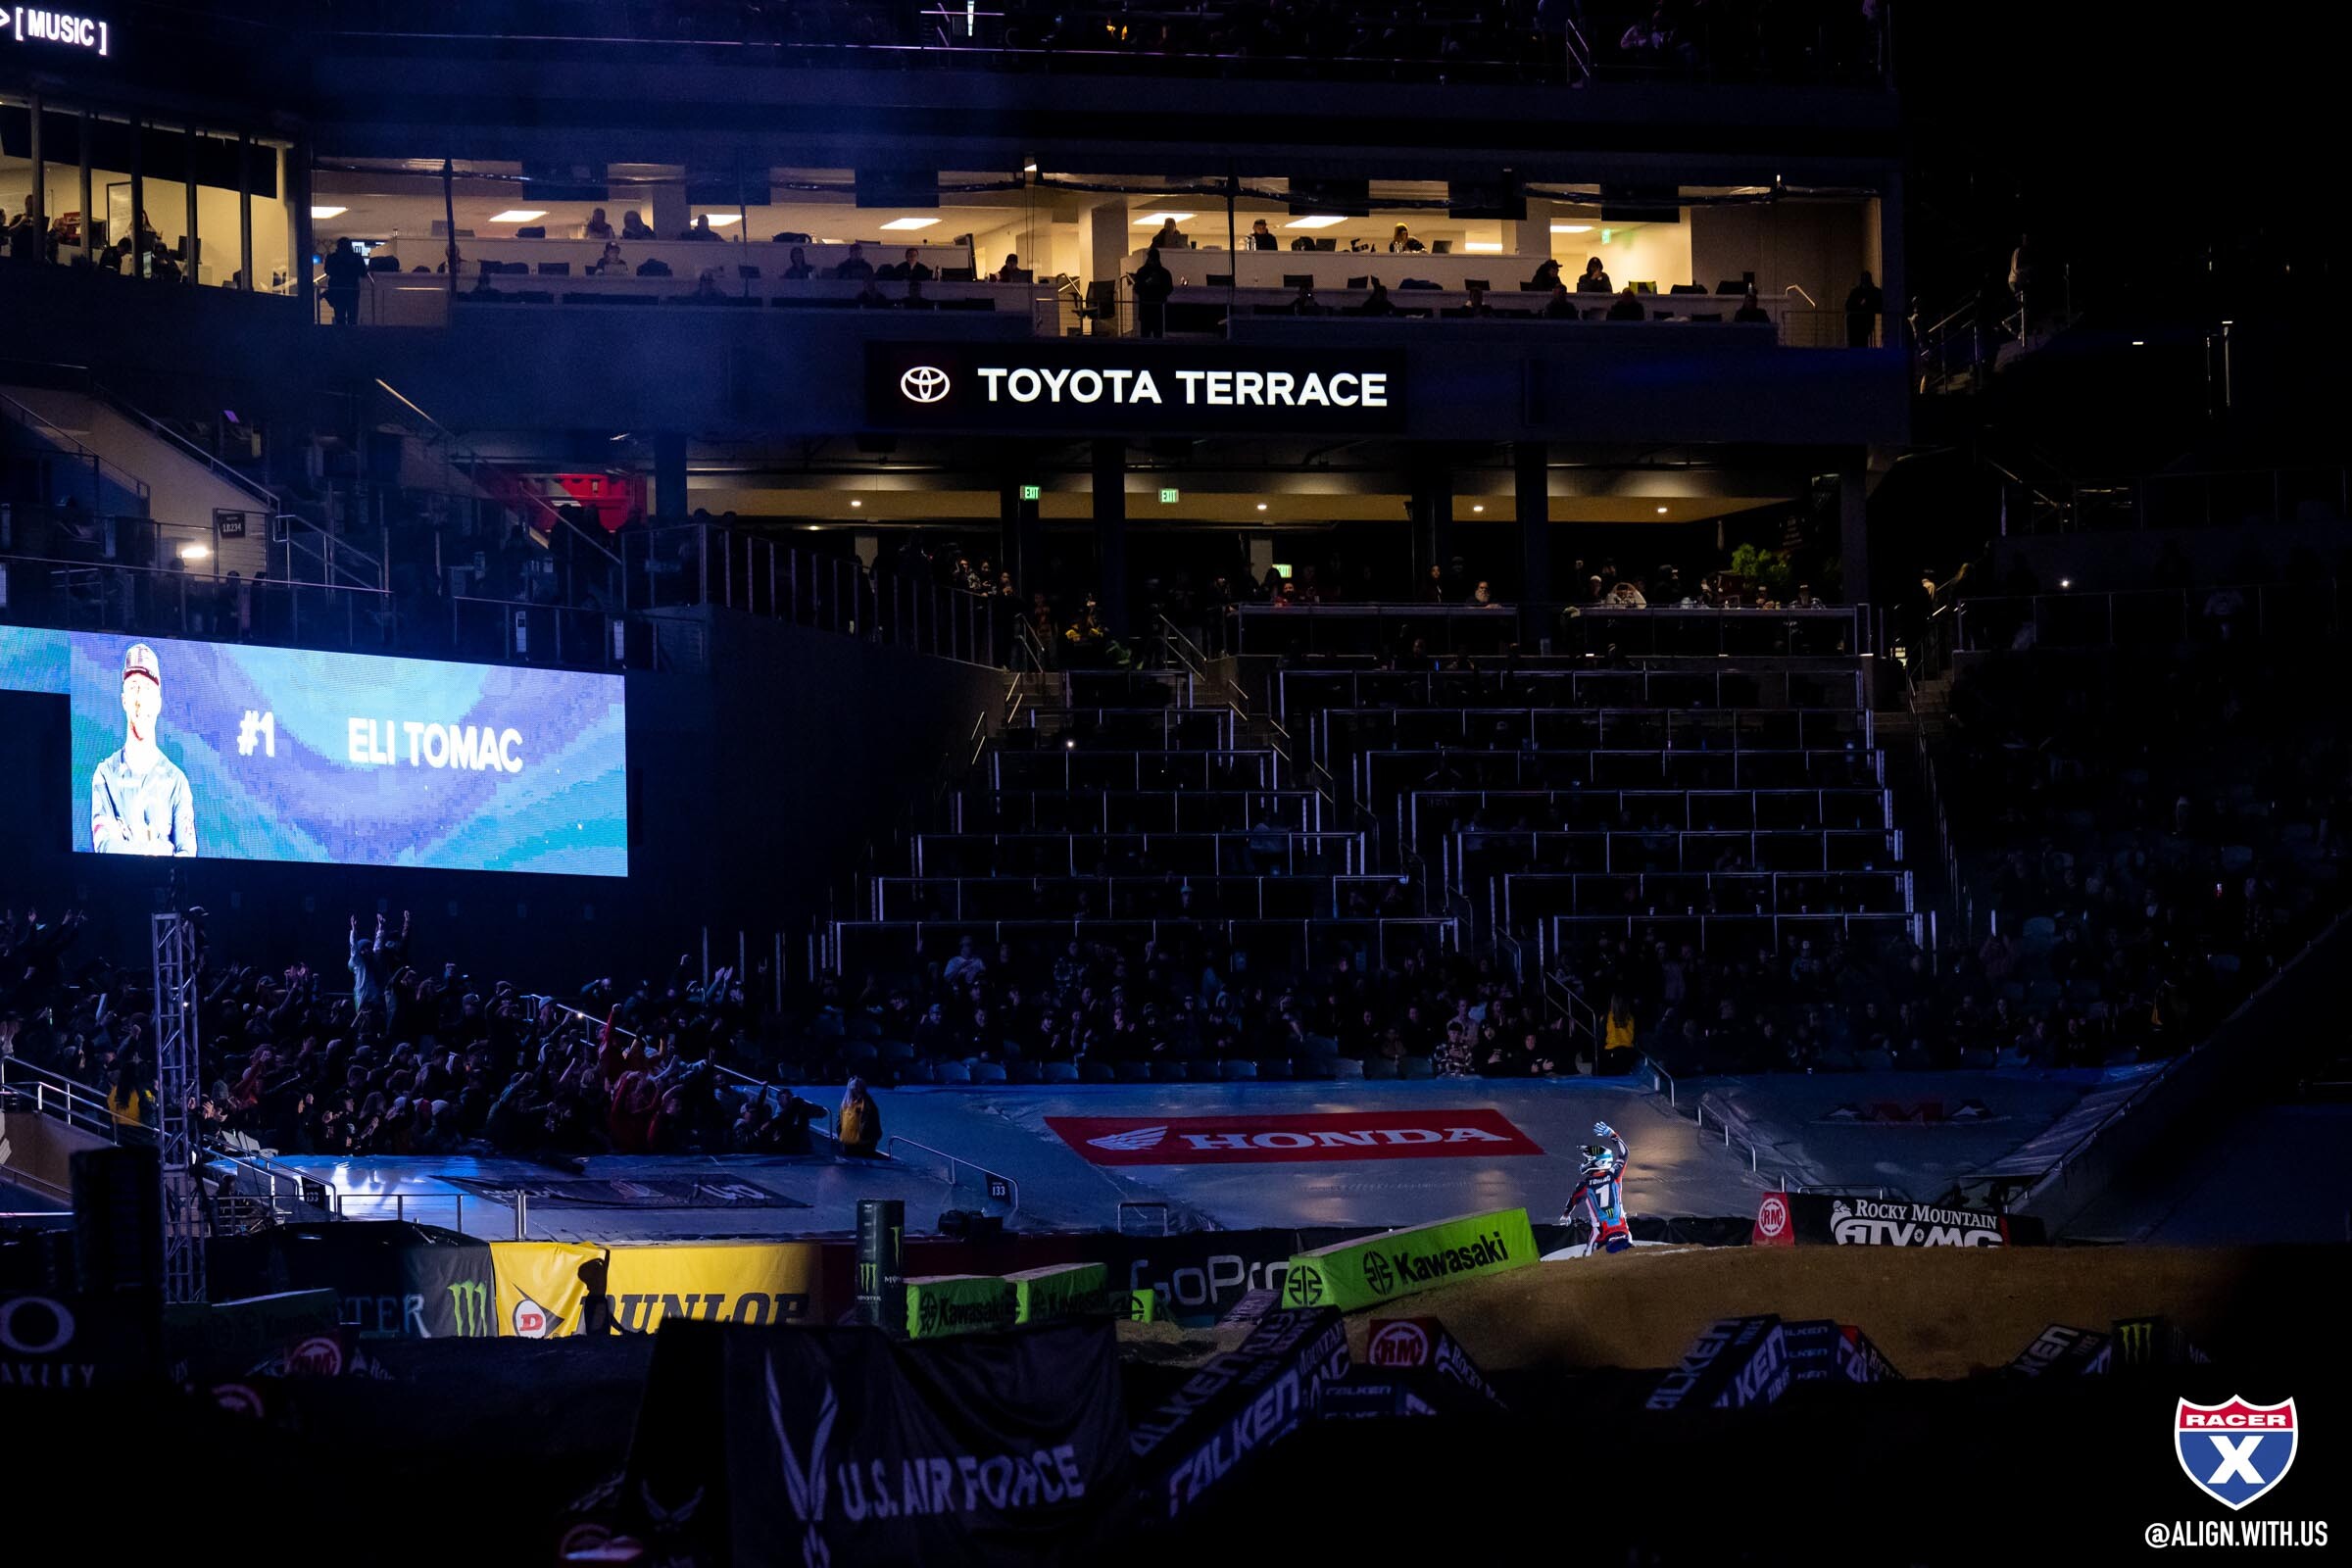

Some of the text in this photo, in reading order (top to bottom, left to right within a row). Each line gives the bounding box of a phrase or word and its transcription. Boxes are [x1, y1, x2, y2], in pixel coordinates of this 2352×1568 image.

[978, 368, 1388, 407] TOYOTA TERRACE
[1024, 486, 1039, 499] EXIT
[1161, 490, 1176, 502] EXIT
[237, 710, 523, 773] #1 ELI TOMAC
[1179, 1127, 1513, 1151] HONDA
[992, 1185, 1005, 1197] 133
[1595, 1184, 1610, 1208] 1
[1856, 1199, 1998, 1230] ROCKY MOUNTAIN
[1394, 1231, 1510, 1283] Kawasaki
[940, 1294, 1007, 1326] Kawasaki
[0, 1361, 95, 1389] AKLEY
[1129, 1350, 1257, 1458] ALKEN
[1169, 1365, 1300, 1519] FALKEN
[837, 1445, 1085, 1521] U.S. AIR FORCE
